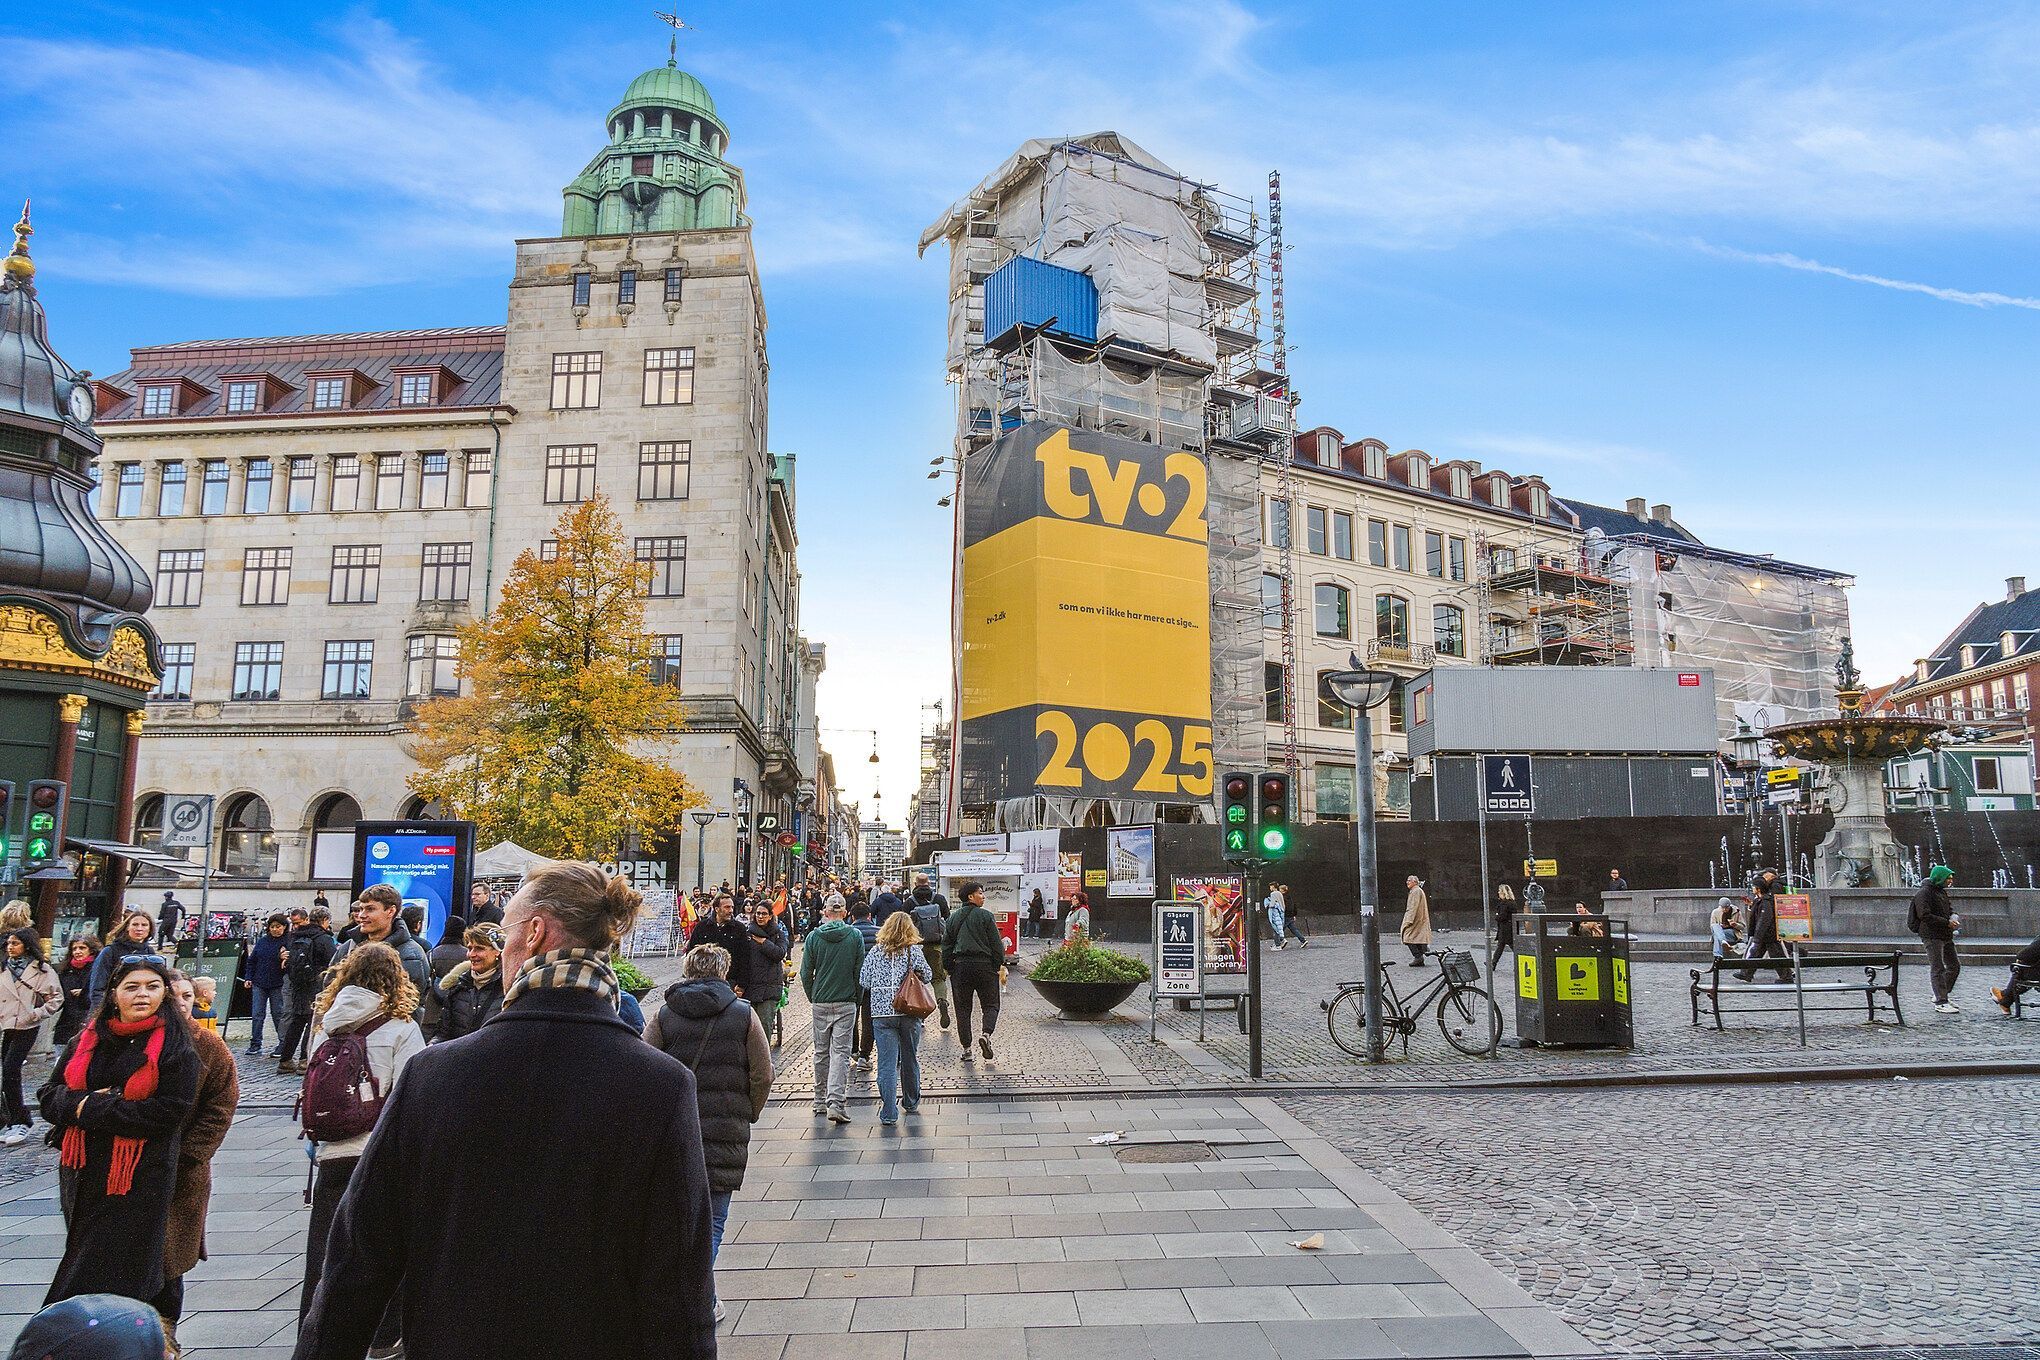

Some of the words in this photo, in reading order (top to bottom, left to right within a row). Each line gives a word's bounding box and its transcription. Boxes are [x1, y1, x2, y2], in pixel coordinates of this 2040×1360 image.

[1058, 603, 1079, 612] som
[1079, 605, 1095, 614] om
[1095, 606, 1105, 615] vi
[1106, 606, 1126, 618] ikke
[1126, 609, 1142, 620] har
[1143, 613, 1165, 623] mere
[1165, 616, 1176, 625] at
[1034, 710, 1214, 796] 2025
[176, 810, 197, 823] 40
[759, 816, 777, 829] JD
[173, 833, 197, 842] Zone
[588, 860, 667, 879] OPEN
[1176, 877, 1203, 886] Marta
[1204, 876, 1239, 887] Minujín
[1204, 961, 1243, 970] mporary
[1166, 981, 1190, 990] Zone
